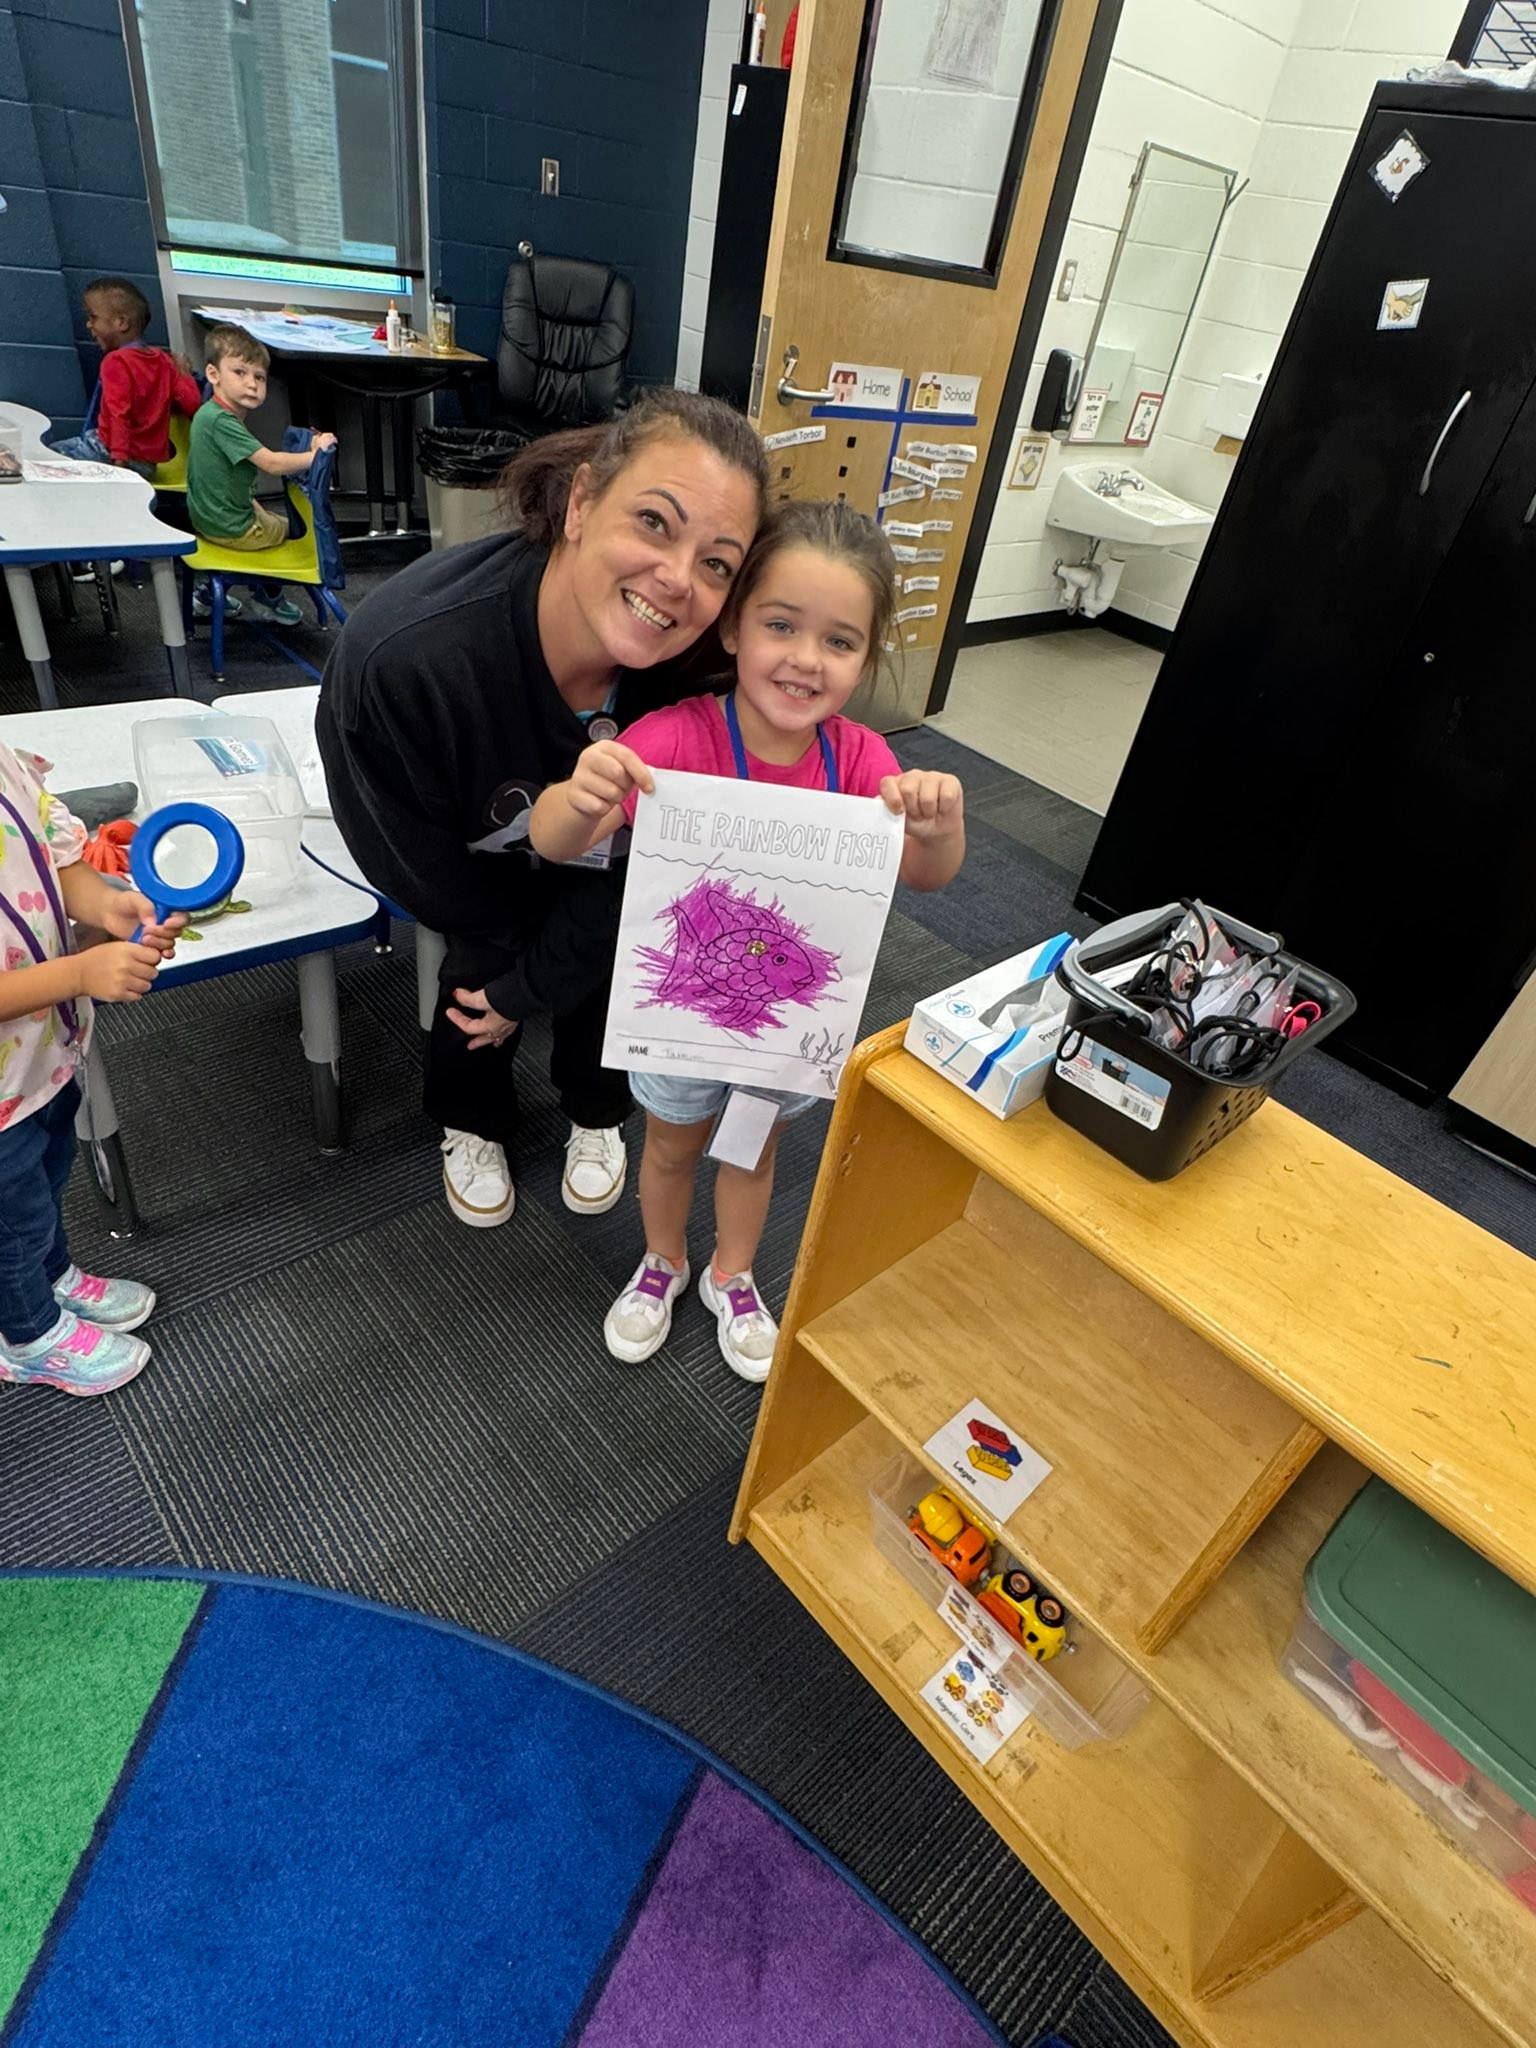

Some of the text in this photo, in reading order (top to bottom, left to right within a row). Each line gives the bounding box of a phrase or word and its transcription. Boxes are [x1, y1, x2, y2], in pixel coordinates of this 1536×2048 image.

[862, 378, 891, 397] Home
[943, 386, 973, 403] School
[660, 804, 889, 870] THE RAINBOW FISH
[628, 1045, 649, 1056] NAME
[953, 1460, 977, 1485] Legos
[935, 1695, 975, 1741] Magnetic Cars
